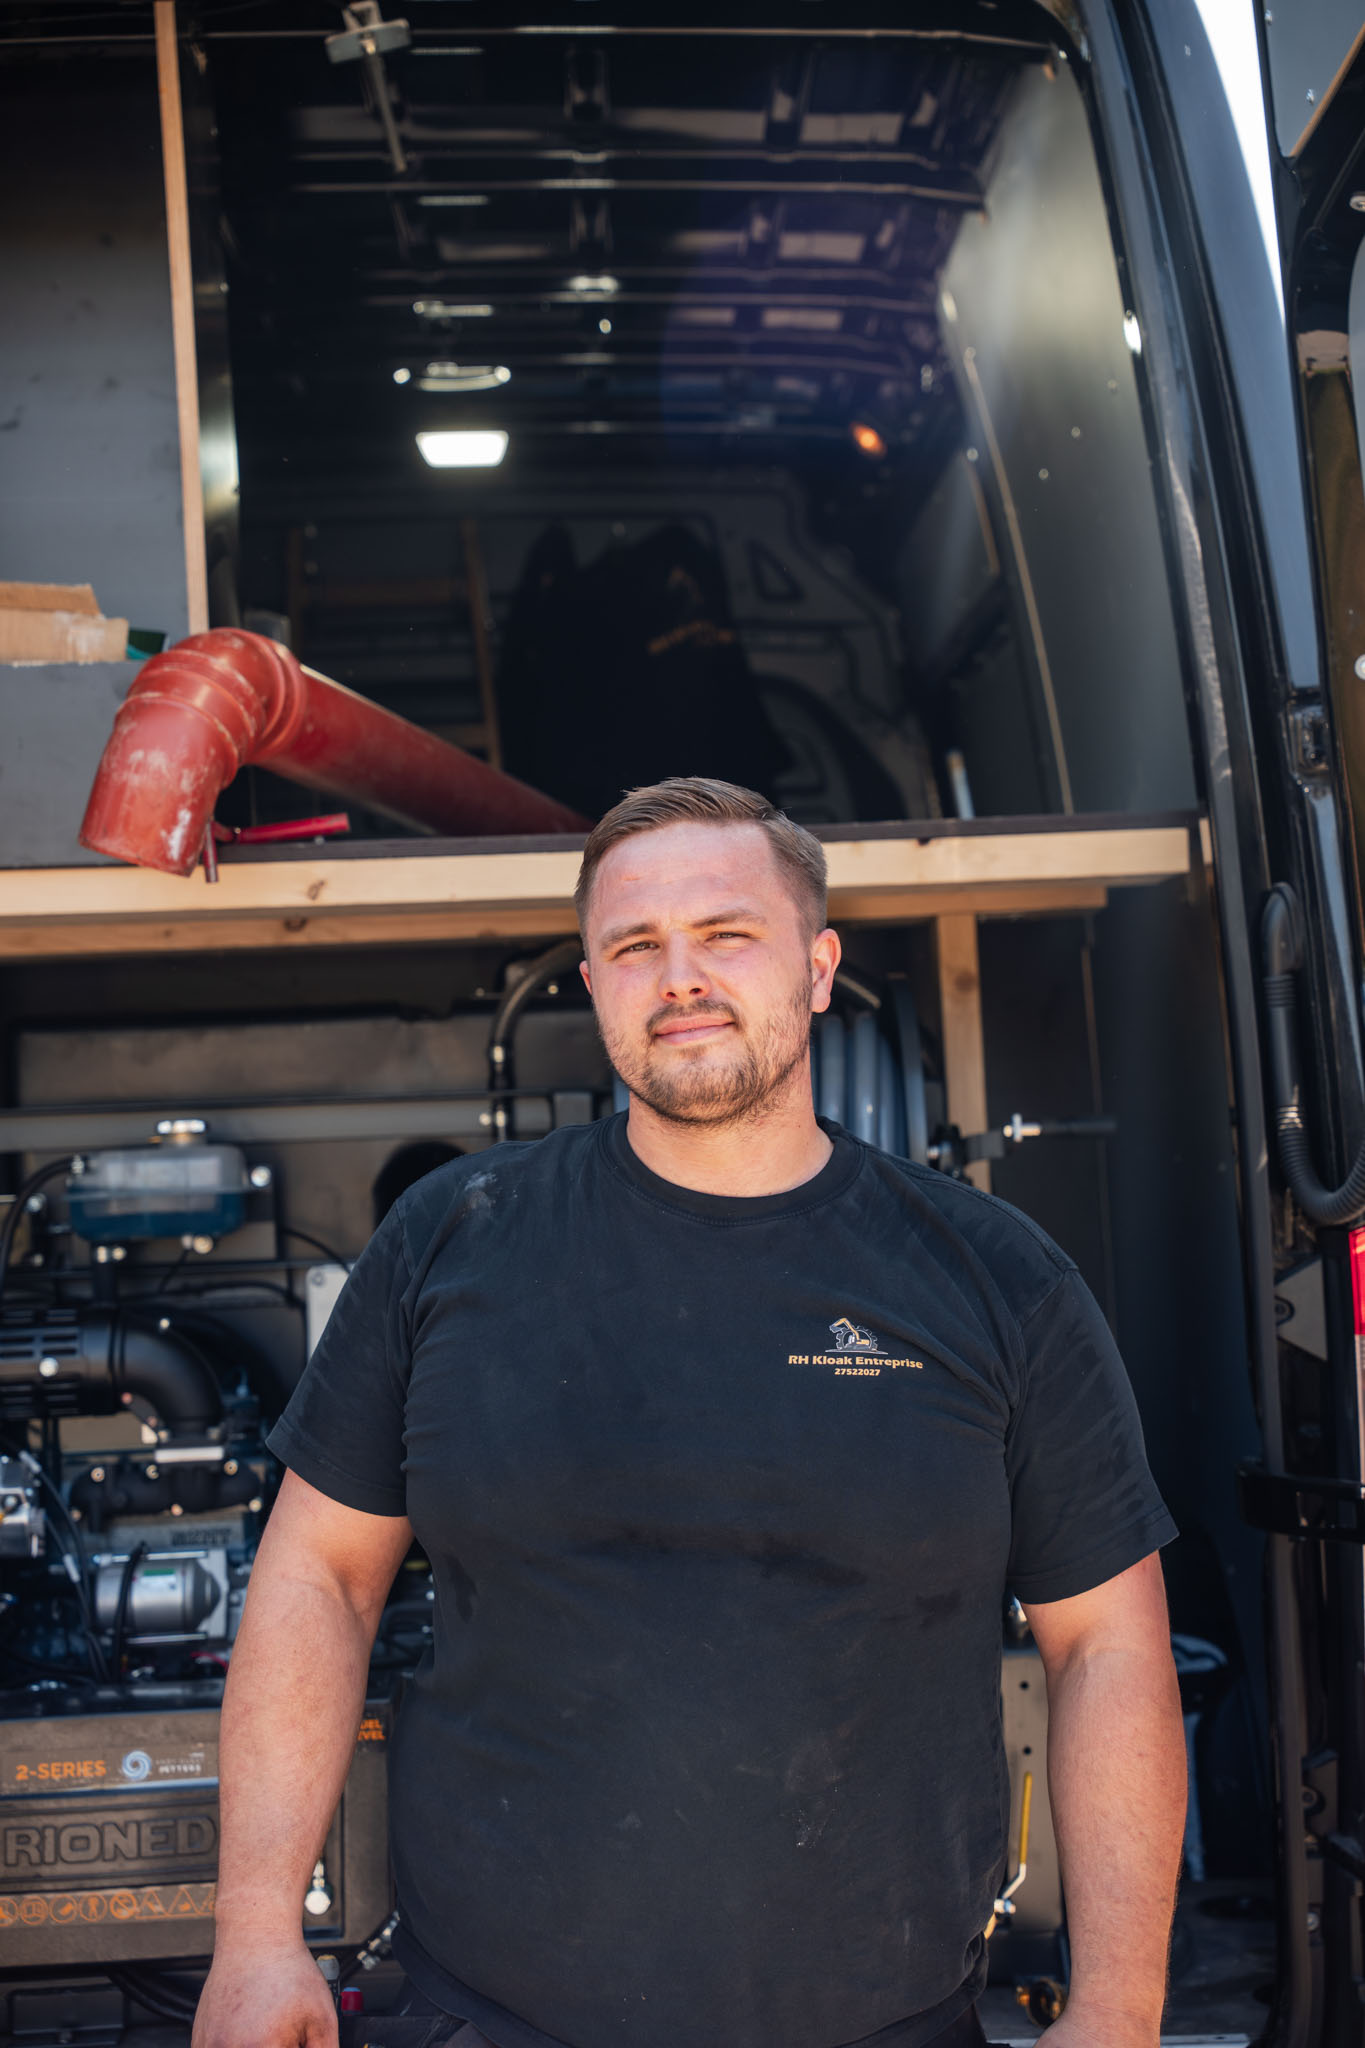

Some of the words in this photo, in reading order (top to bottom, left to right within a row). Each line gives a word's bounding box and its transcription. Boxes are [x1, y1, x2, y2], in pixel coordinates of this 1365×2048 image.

[788, 1355, 809, 1365] RH
[812, 1355, 853, 1365] Kloak
[855, 1356, 923, 1369] Entreprise
[834, 1368, 881, 1376] 27522027
[15, 1759, 107, 1781] 2-SERIES
[4, 1815, 217, 1867] RIONED
